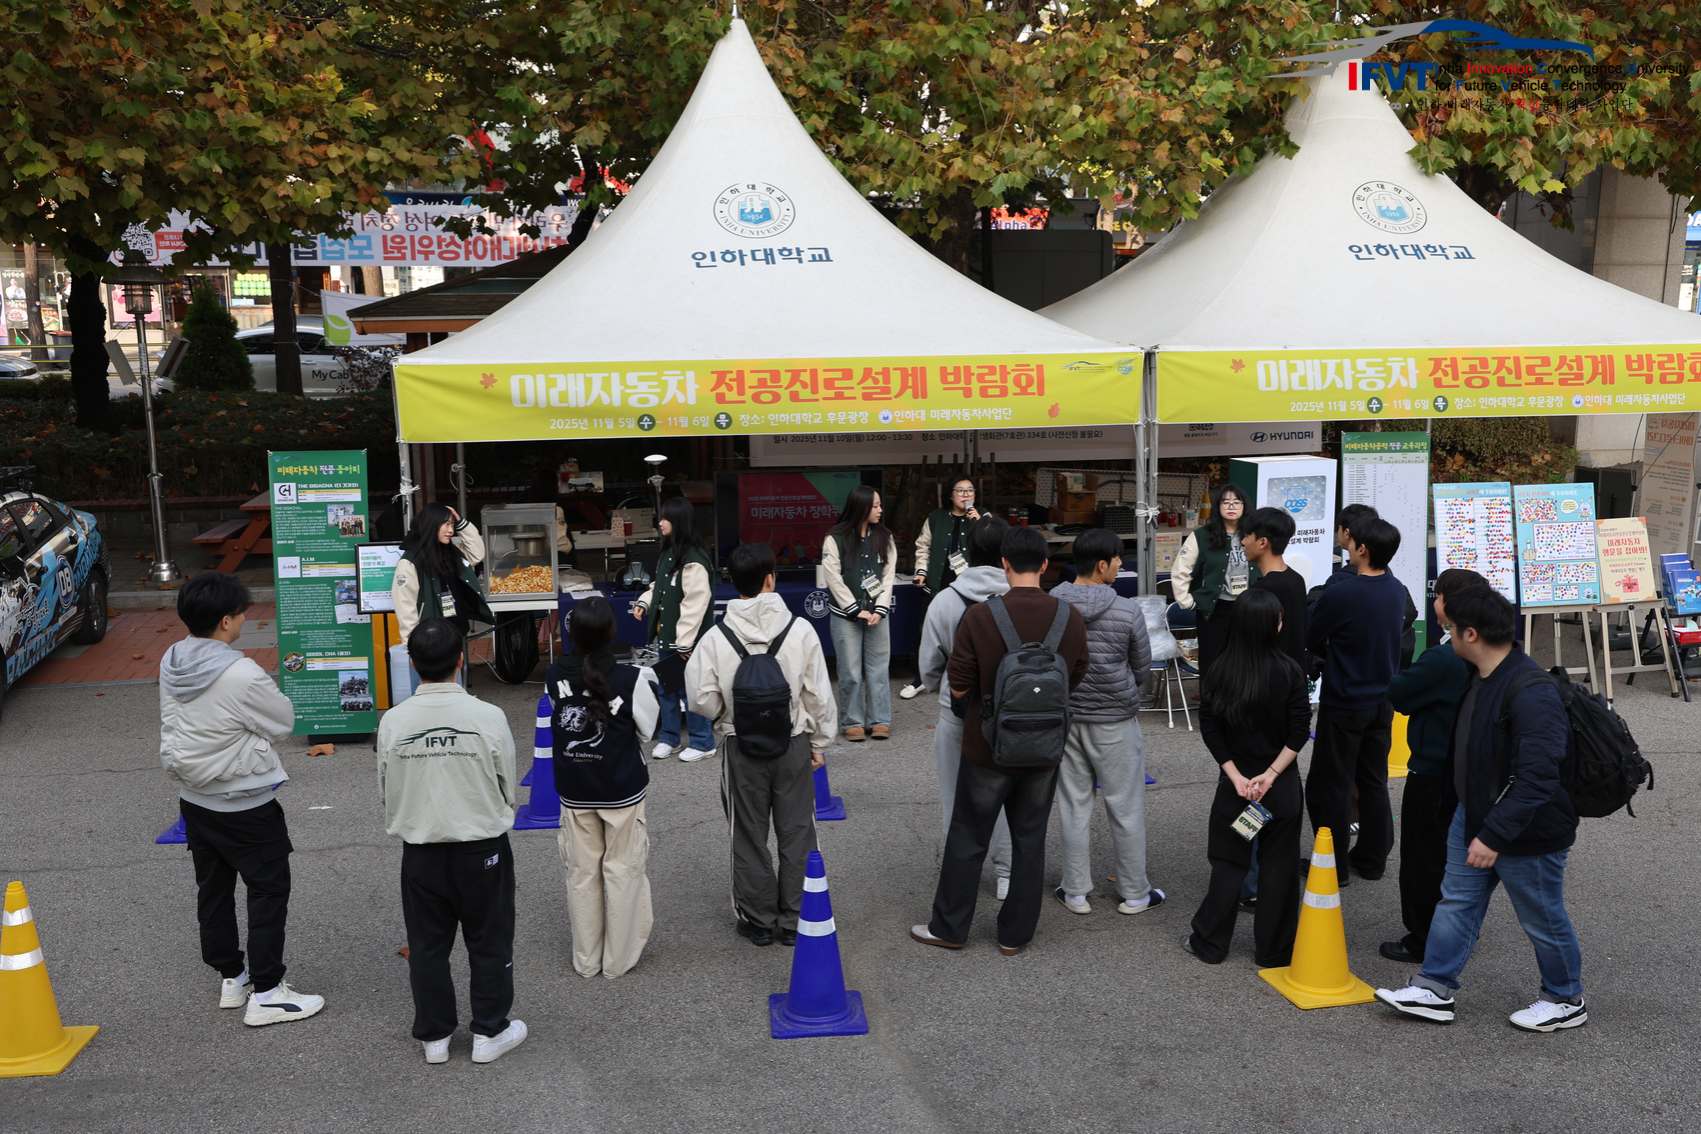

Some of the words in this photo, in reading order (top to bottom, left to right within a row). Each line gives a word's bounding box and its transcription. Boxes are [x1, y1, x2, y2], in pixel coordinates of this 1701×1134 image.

[719, 184, 786, 205] 인하대학교
[740, 213, 791, 235] UNIVERSITY
[691, 247, 833, 268] 인하대학교
[1348, 243, 1476, 260] 인하대학교
[1256, 356, 1419, 392] 미래자동차
[1427, 354, 1615, 389] 전공진로설계
[510, 370, 700, 409] 미래자동차
[709, 366, 928, 404] 전공진로설계
[939, 363, 1045, 400] 박람회
[1290, 401, 1325, 412] 2025년
[1327, 400, 1347, 412] 11월
[1350, 400, 1365, 411] 5일
[1392, 398, 1411, 411] 11월
[1414, 398, 1430, 410] 6일
[1454, 397, 1476, 409] 장소:
[1478, 396, 1525, 409] 인하대학교
[1527, 396, 1564, 408] 후문광장
[1584, 394, 1613, 405] 인하대
[1615, 392, 1686, 406] 미래자동차사업단
[549, 418, 589, 430] 2025년
[592, 417, 614, 429] 11월
[618, 417, 636, 429] 5일
[667, 415, 689, 428] 11월
[692, 414, 710, 427] 6일
[738, 413, 764, 426] 장소:
[767, 411, 823, 426] 인하대학교
[826, 410, 869, 423] 후문광장
[894, 409, 926, 421] 인하대
[930, 407, 1012, 421] 미래자동차사업단
[773, 435, 788, 444] 일시
[790, 434, 817, 444] 2025년
[818, 434, 835, 443] 11월
[836, 433, 865, 444] 10일(월)
[866, 434, 887, 442] 12:00
[892, 433, 913, 441] 13:30
[921, 432, 936, 441] 장소
[979, 430, 1026, 442] 생회관(7호관)
[1027, 430, 1047, 440] 334호
[1048, 430, 1079, 440] (사전신청
[1080, 429, 1103, 439] 불필요)
[1269, 430, 1314, 441] HYUNDAI
[1389, 442, 1402, 450] 전공
[1402, 441, 1427, 450] 교육과정
[277, 465, 318, 476] 미래자동차
[319, 464, 335, 475] 전공
[751, 506, 808, 519] 미래자동차
[809, 505, 843, 519] 장학퀴
[1297, 528, 1325, 536] 미래자동차
[1303, 536, 1320, 544] 박람회
[1607, 538, 1640, 547] 미래자동차
[425, 736, 457, 748] IFVT
[575, 752, 603, 761] University
[1238, 816, 1259, 833] STAFF
